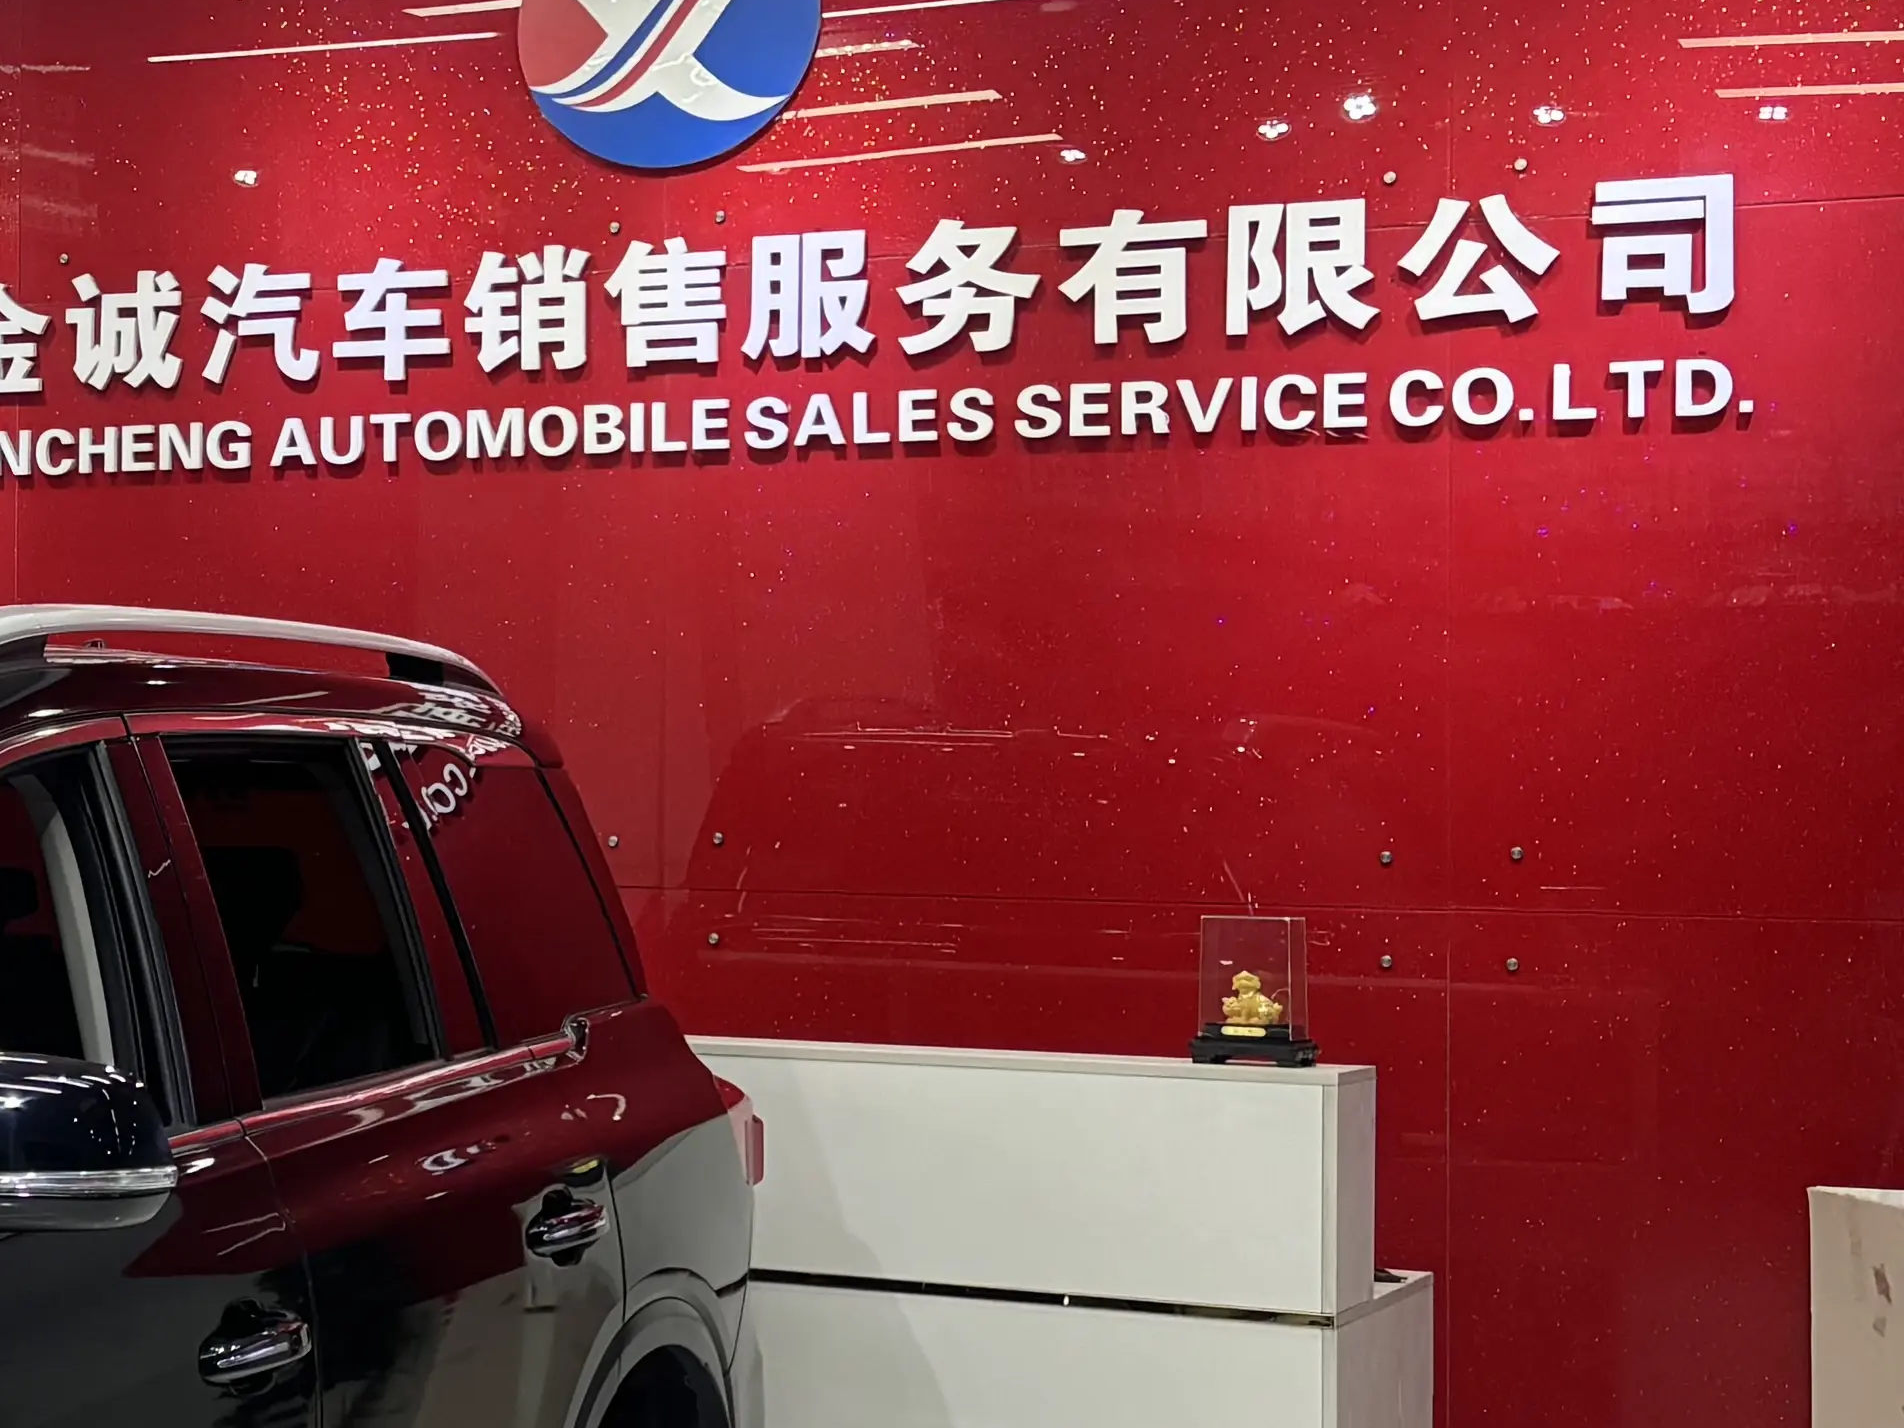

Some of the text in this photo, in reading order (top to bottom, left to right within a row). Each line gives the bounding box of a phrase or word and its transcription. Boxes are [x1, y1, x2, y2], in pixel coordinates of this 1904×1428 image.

[268, 397, 730, 468] AUTOMOBILE
[743, 387, 995, 450] SALES
[1014, 372, 1368, 440] SERVICE
